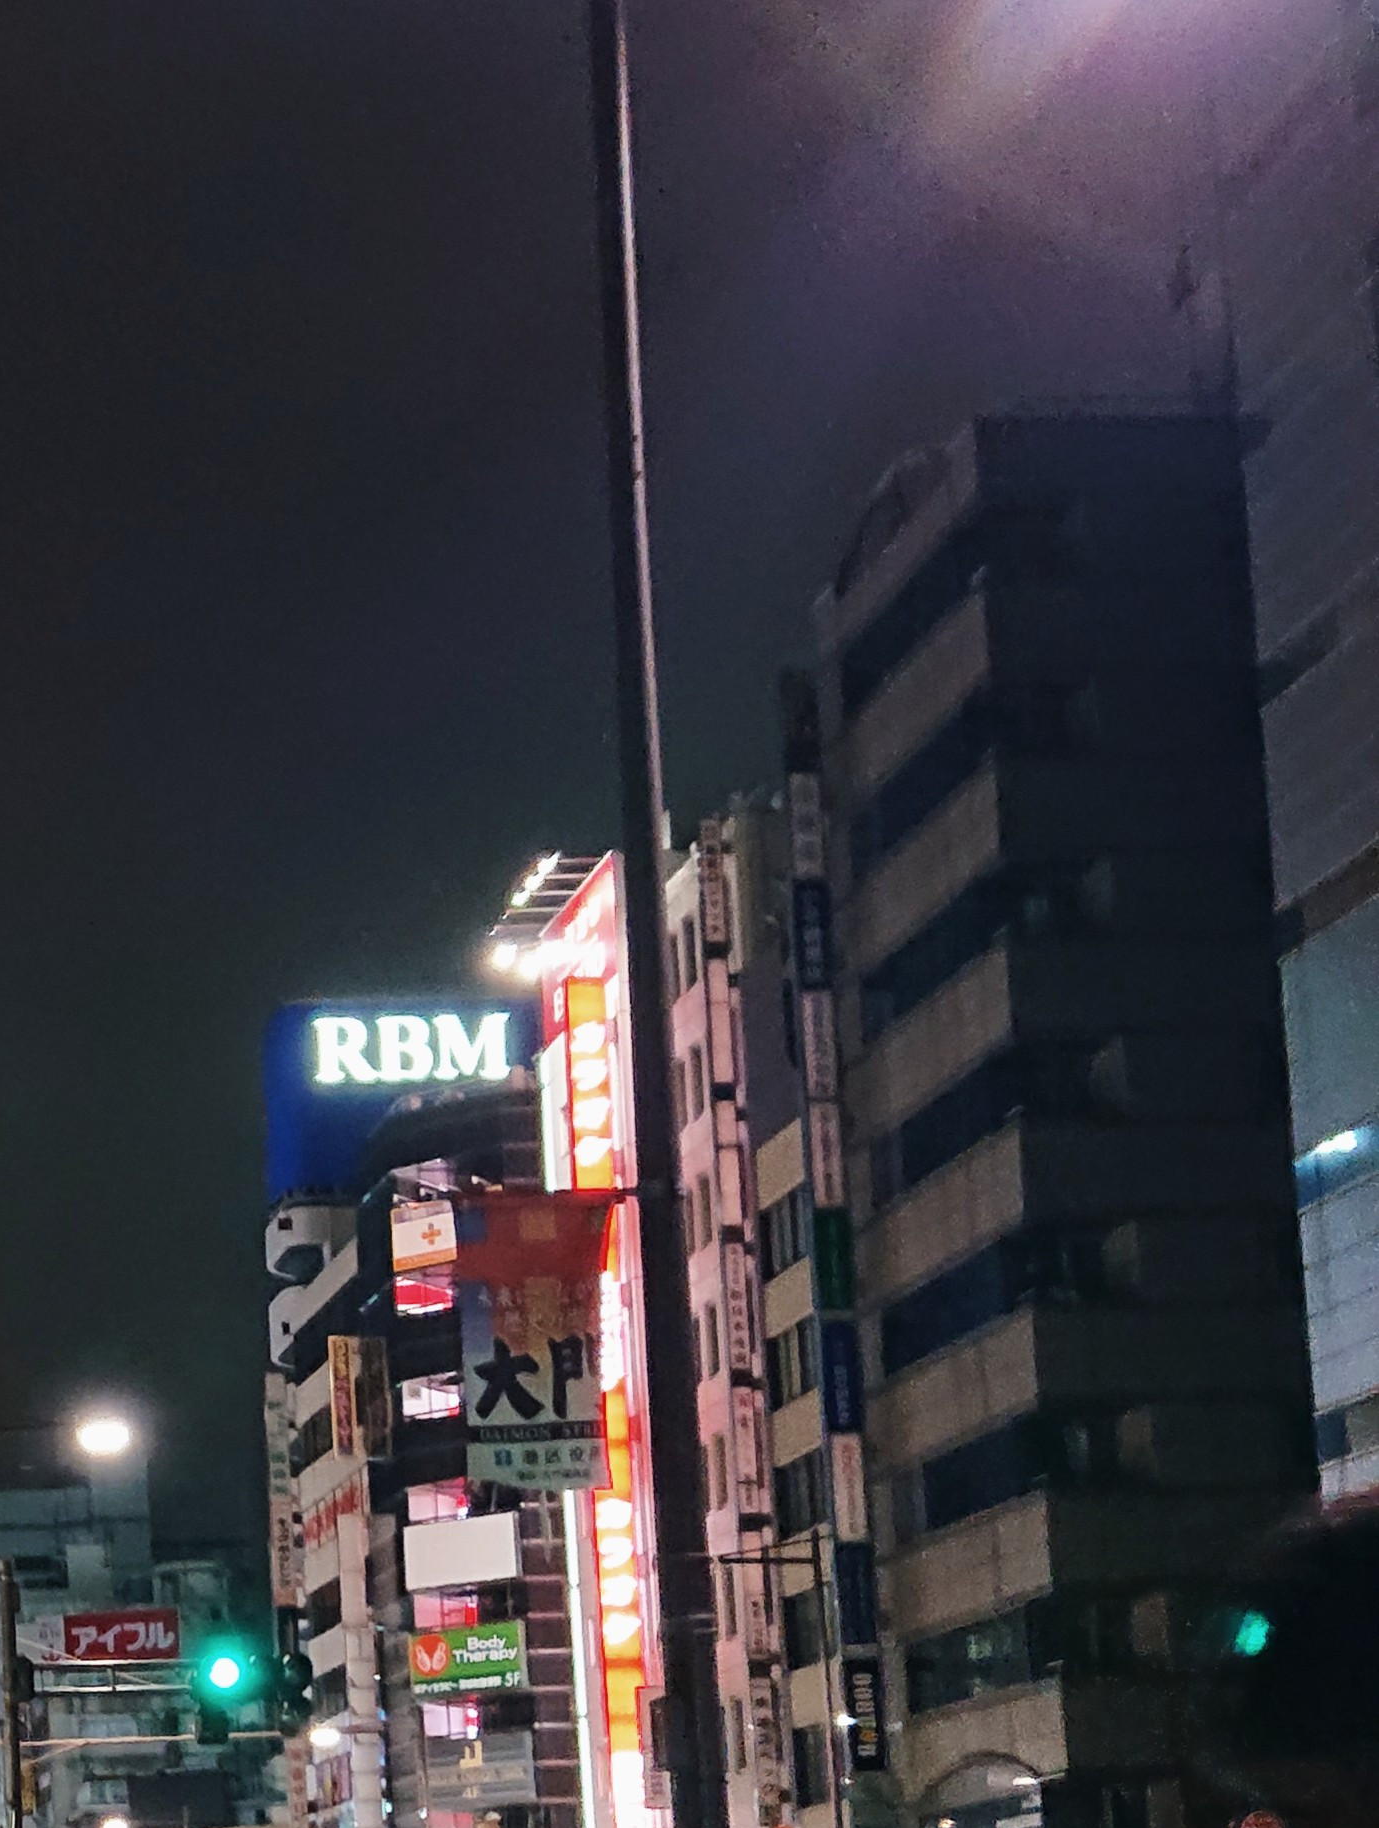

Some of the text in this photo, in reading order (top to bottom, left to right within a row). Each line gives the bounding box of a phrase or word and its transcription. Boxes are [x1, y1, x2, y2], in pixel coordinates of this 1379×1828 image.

[311, 1012, 513, 1083] RBM
[479, 1426, 551, 1442] DAIMON
[71, 1622, 175, 1656] アイフル
[467, 1635, 507, 1651] Body
[452, 1646, 518, 1664] Therapy
